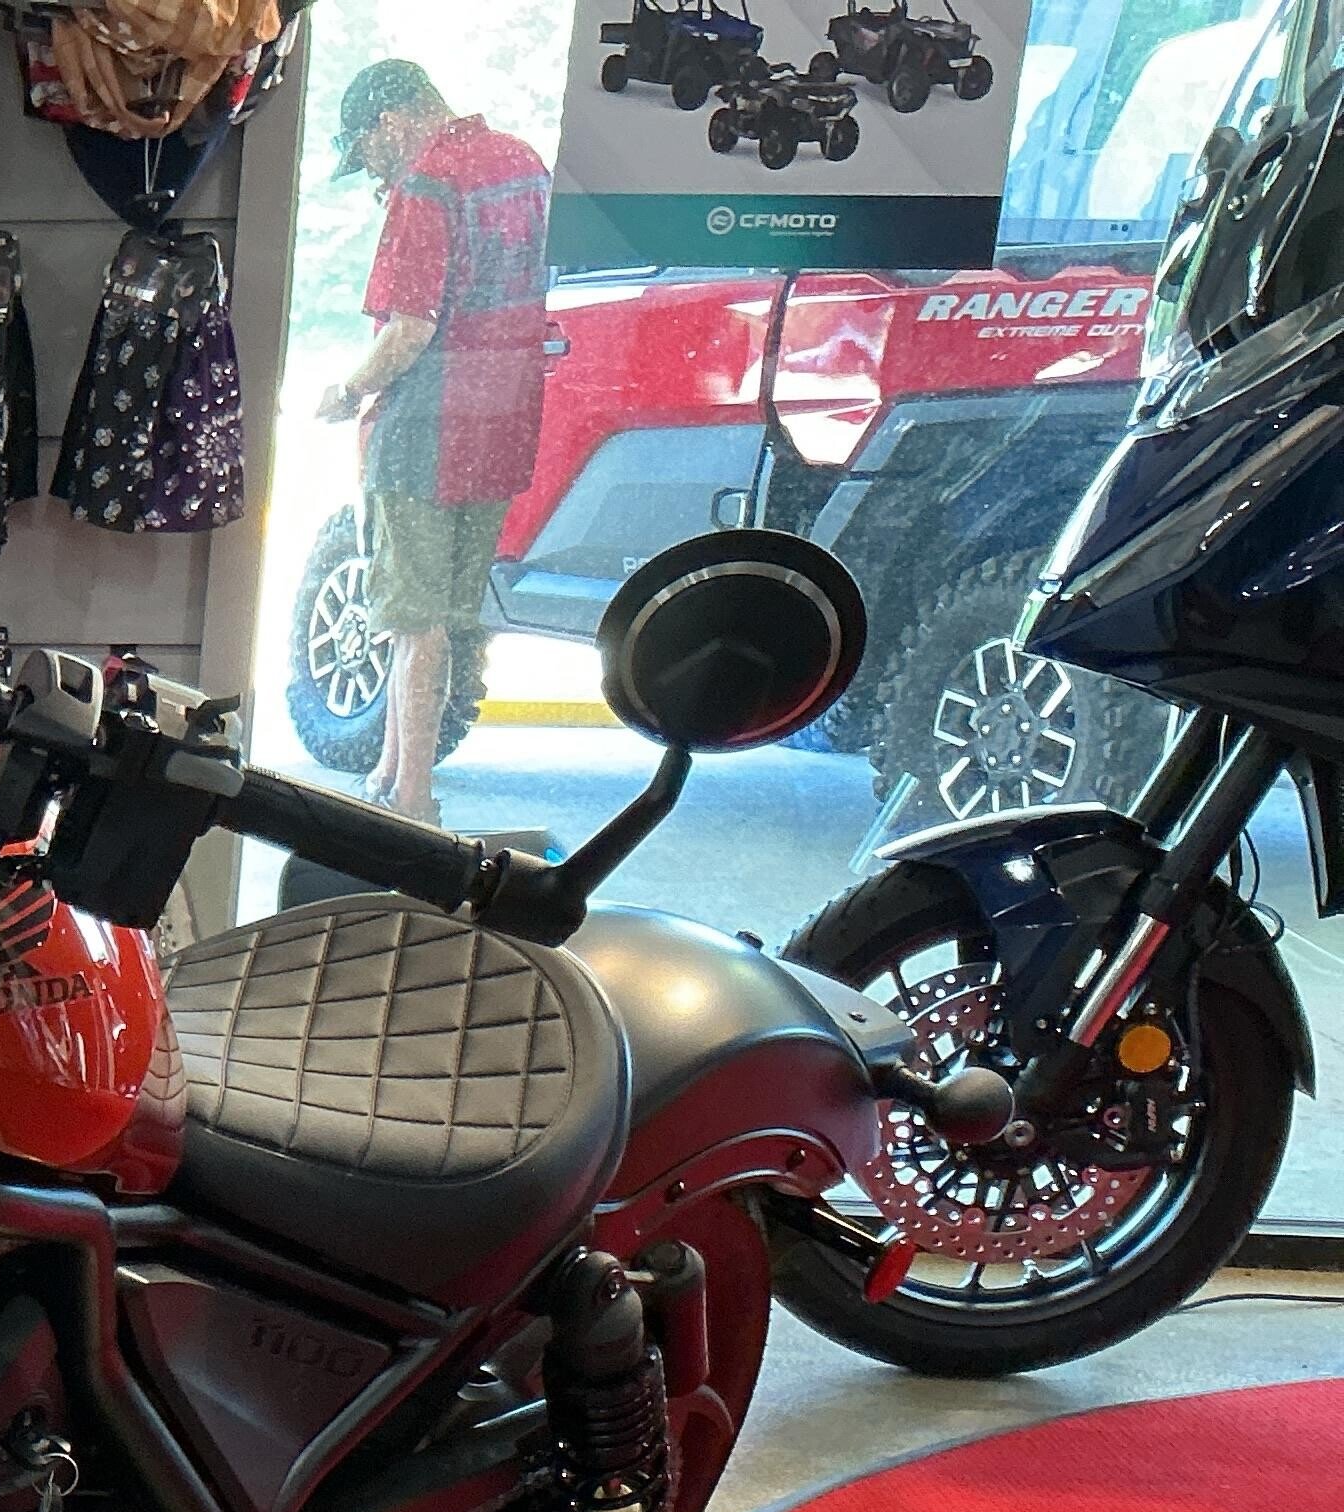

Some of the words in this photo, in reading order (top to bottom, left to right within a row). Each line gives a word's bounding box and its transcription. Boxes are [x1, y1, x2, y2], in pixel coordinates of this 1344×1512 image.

[739, 213, 837, 228] CFMOTO
[916, 286, 1150, 321] RANGER
[977, 324, 1083, 339] EXTREME
